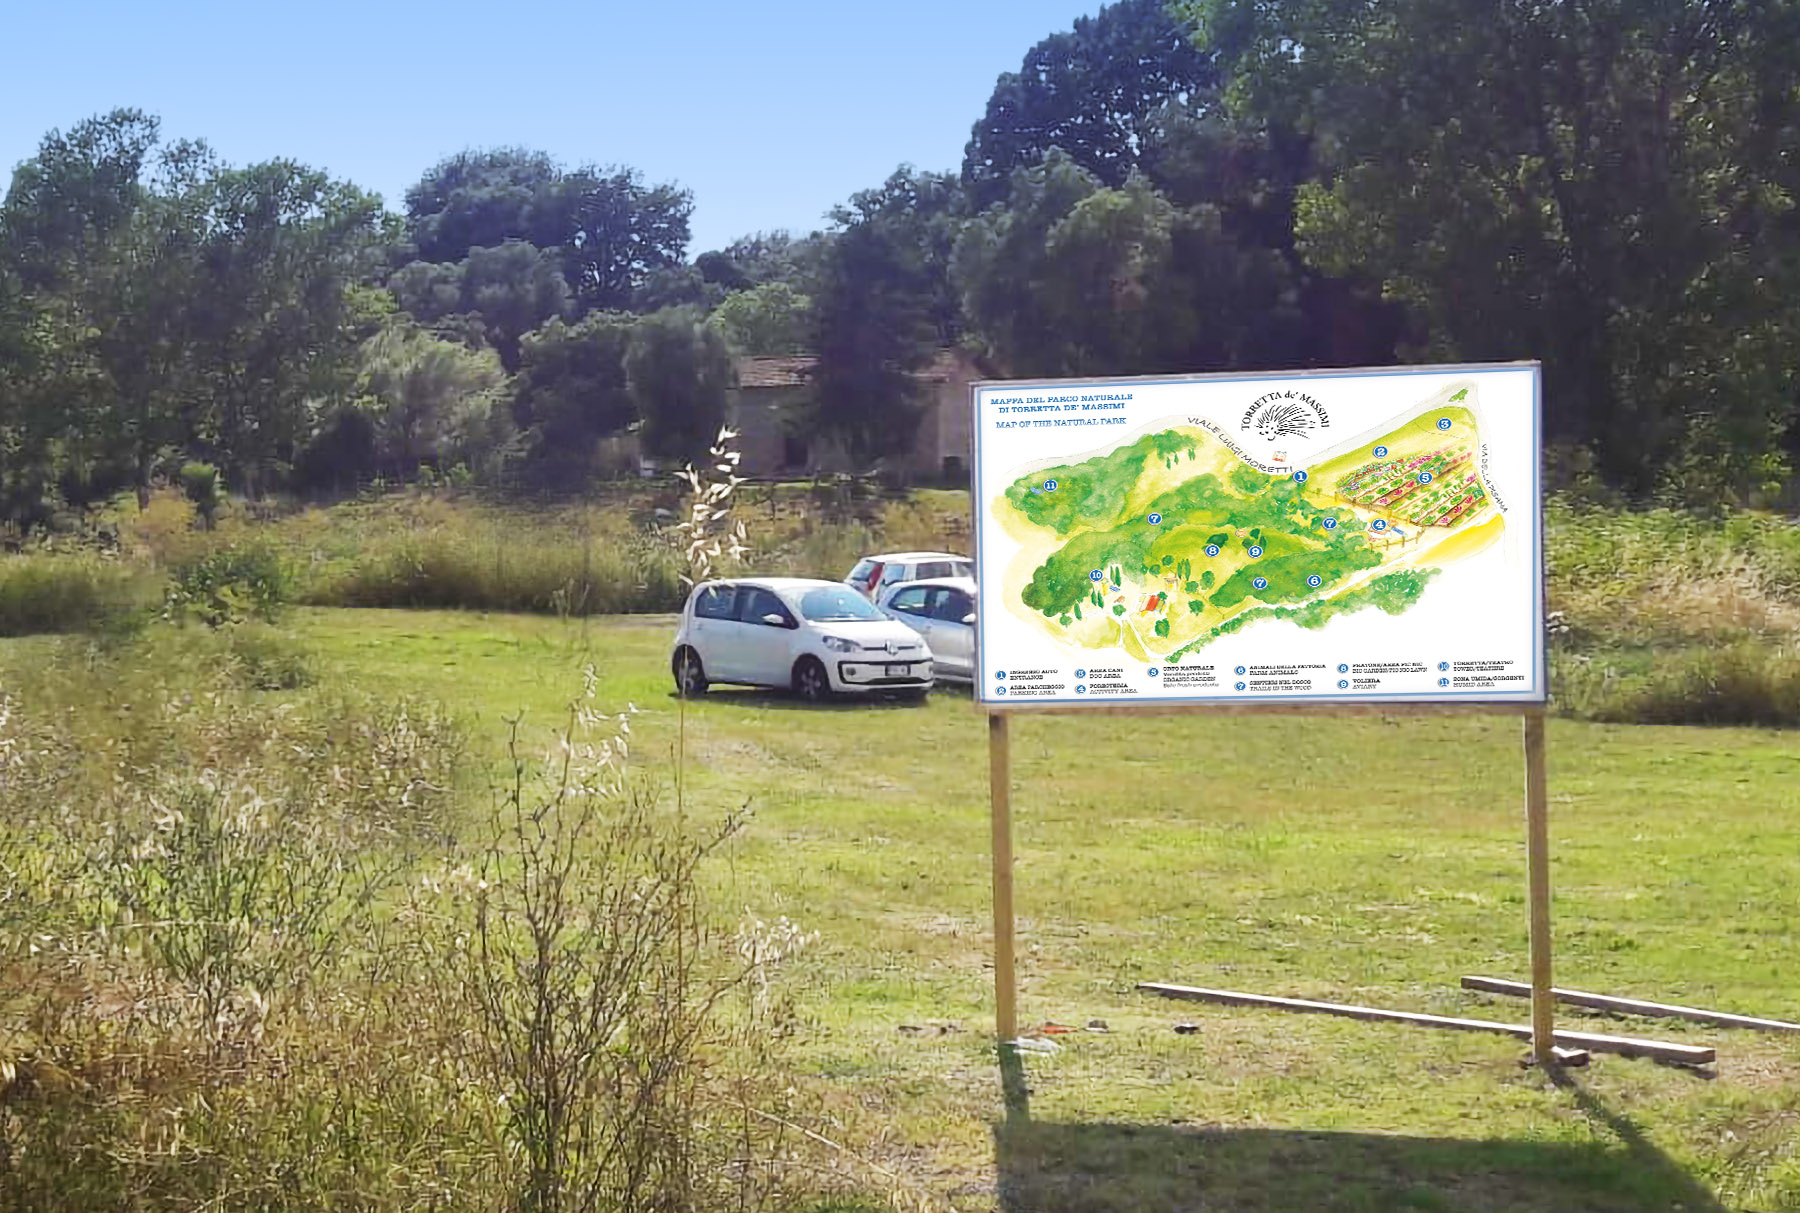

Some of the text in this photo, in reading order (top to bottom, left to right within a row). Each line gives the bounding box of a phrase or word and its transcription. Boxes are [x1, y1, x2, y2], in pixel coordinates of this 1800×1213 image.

[990, 397, 1024, 405] MAPPA
[1047, 395, 1078, 403] PARCO
[1081, 394, 1133, 402] NATURALE
[1011, 405, 1061, 413] TORRETTA
[1241, 390, 1330, 431] TORRETTA de' MASSIMI
[996, 421, 1018, 429] MAP
[1019, 420, 1031, 428] OF
[1100, 417, 1127, 425] PARK
[1187, 417, 1293, 473] VIALE LUIGI MORETTI
